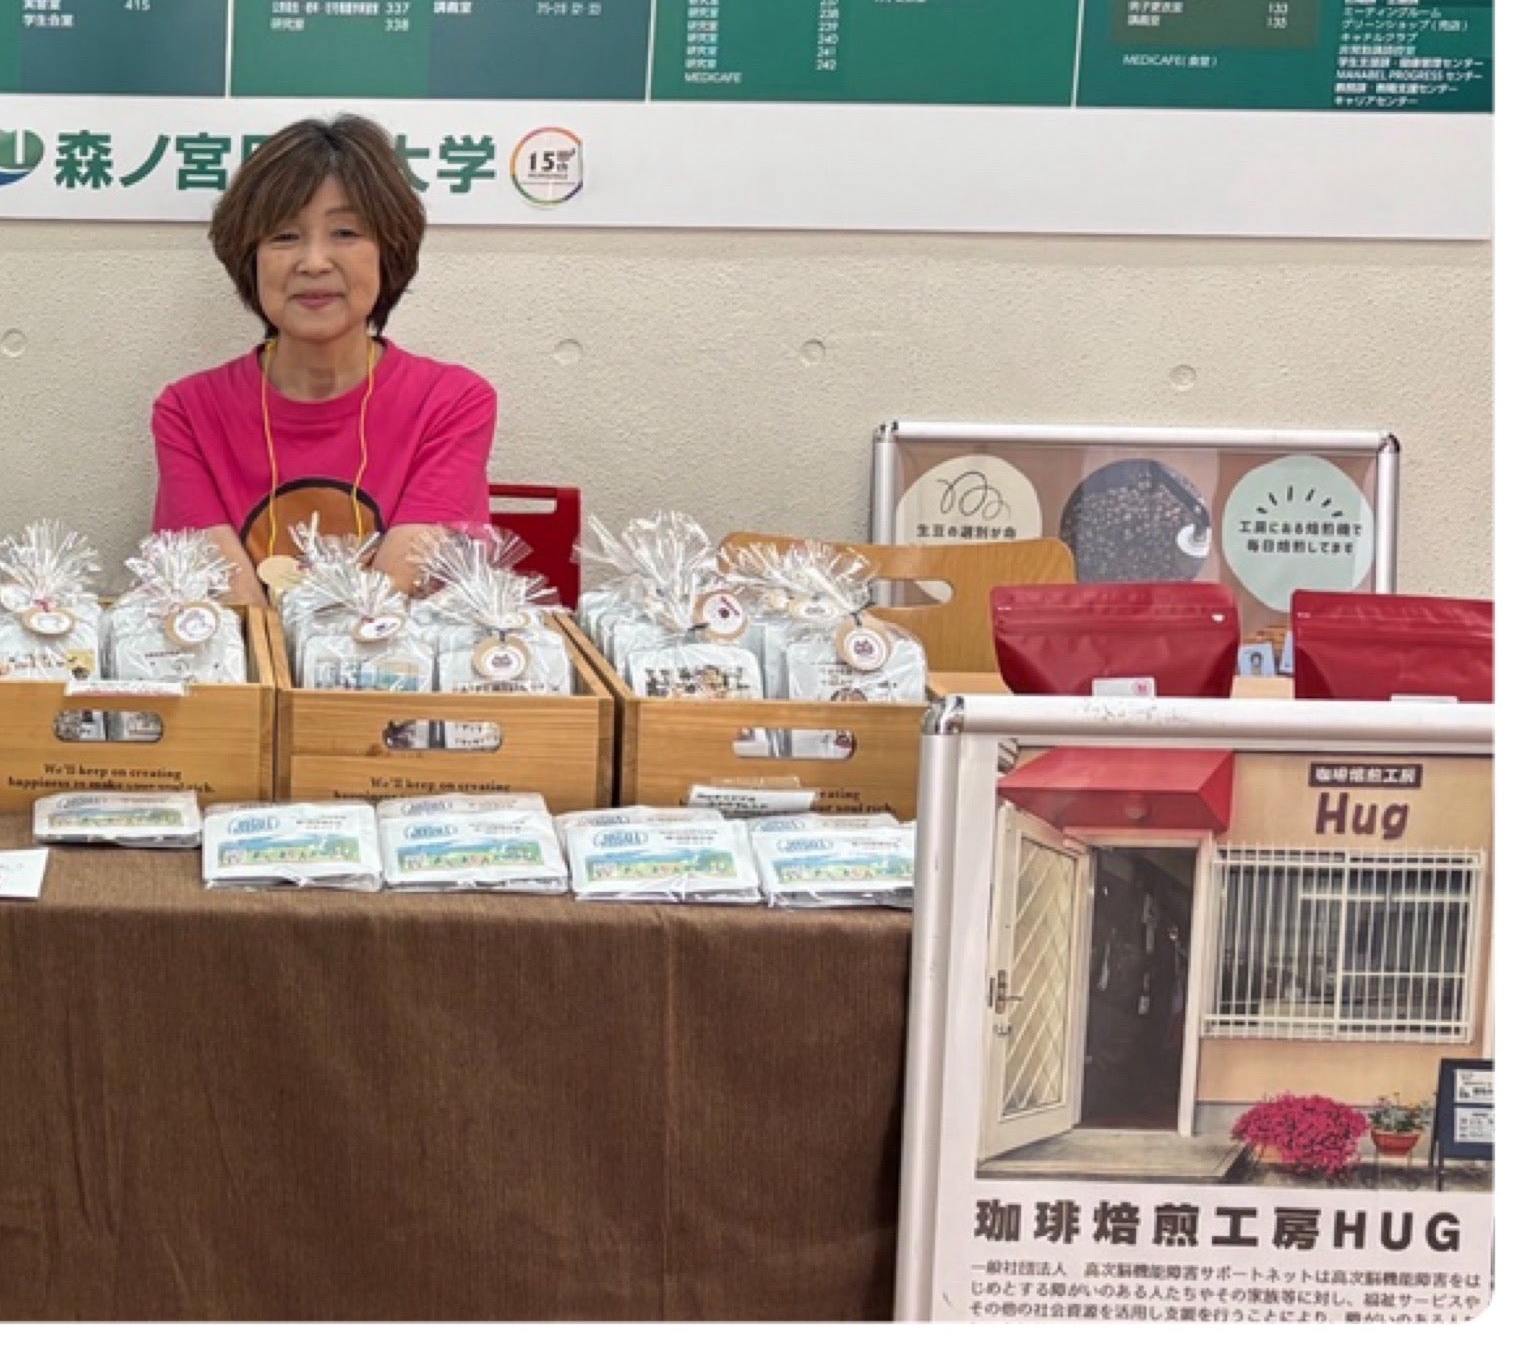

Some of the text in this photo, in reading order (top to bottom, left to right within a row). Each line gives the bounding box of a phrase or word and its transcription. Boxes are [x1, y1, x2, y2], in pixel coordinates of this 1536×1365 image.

[54, 130, 497, 194] 森ノ宮大学
[1315, 791, 1409, 840] Hug
[973, 1198, 1462, 1252] 珈琲焙煎工房HUG
